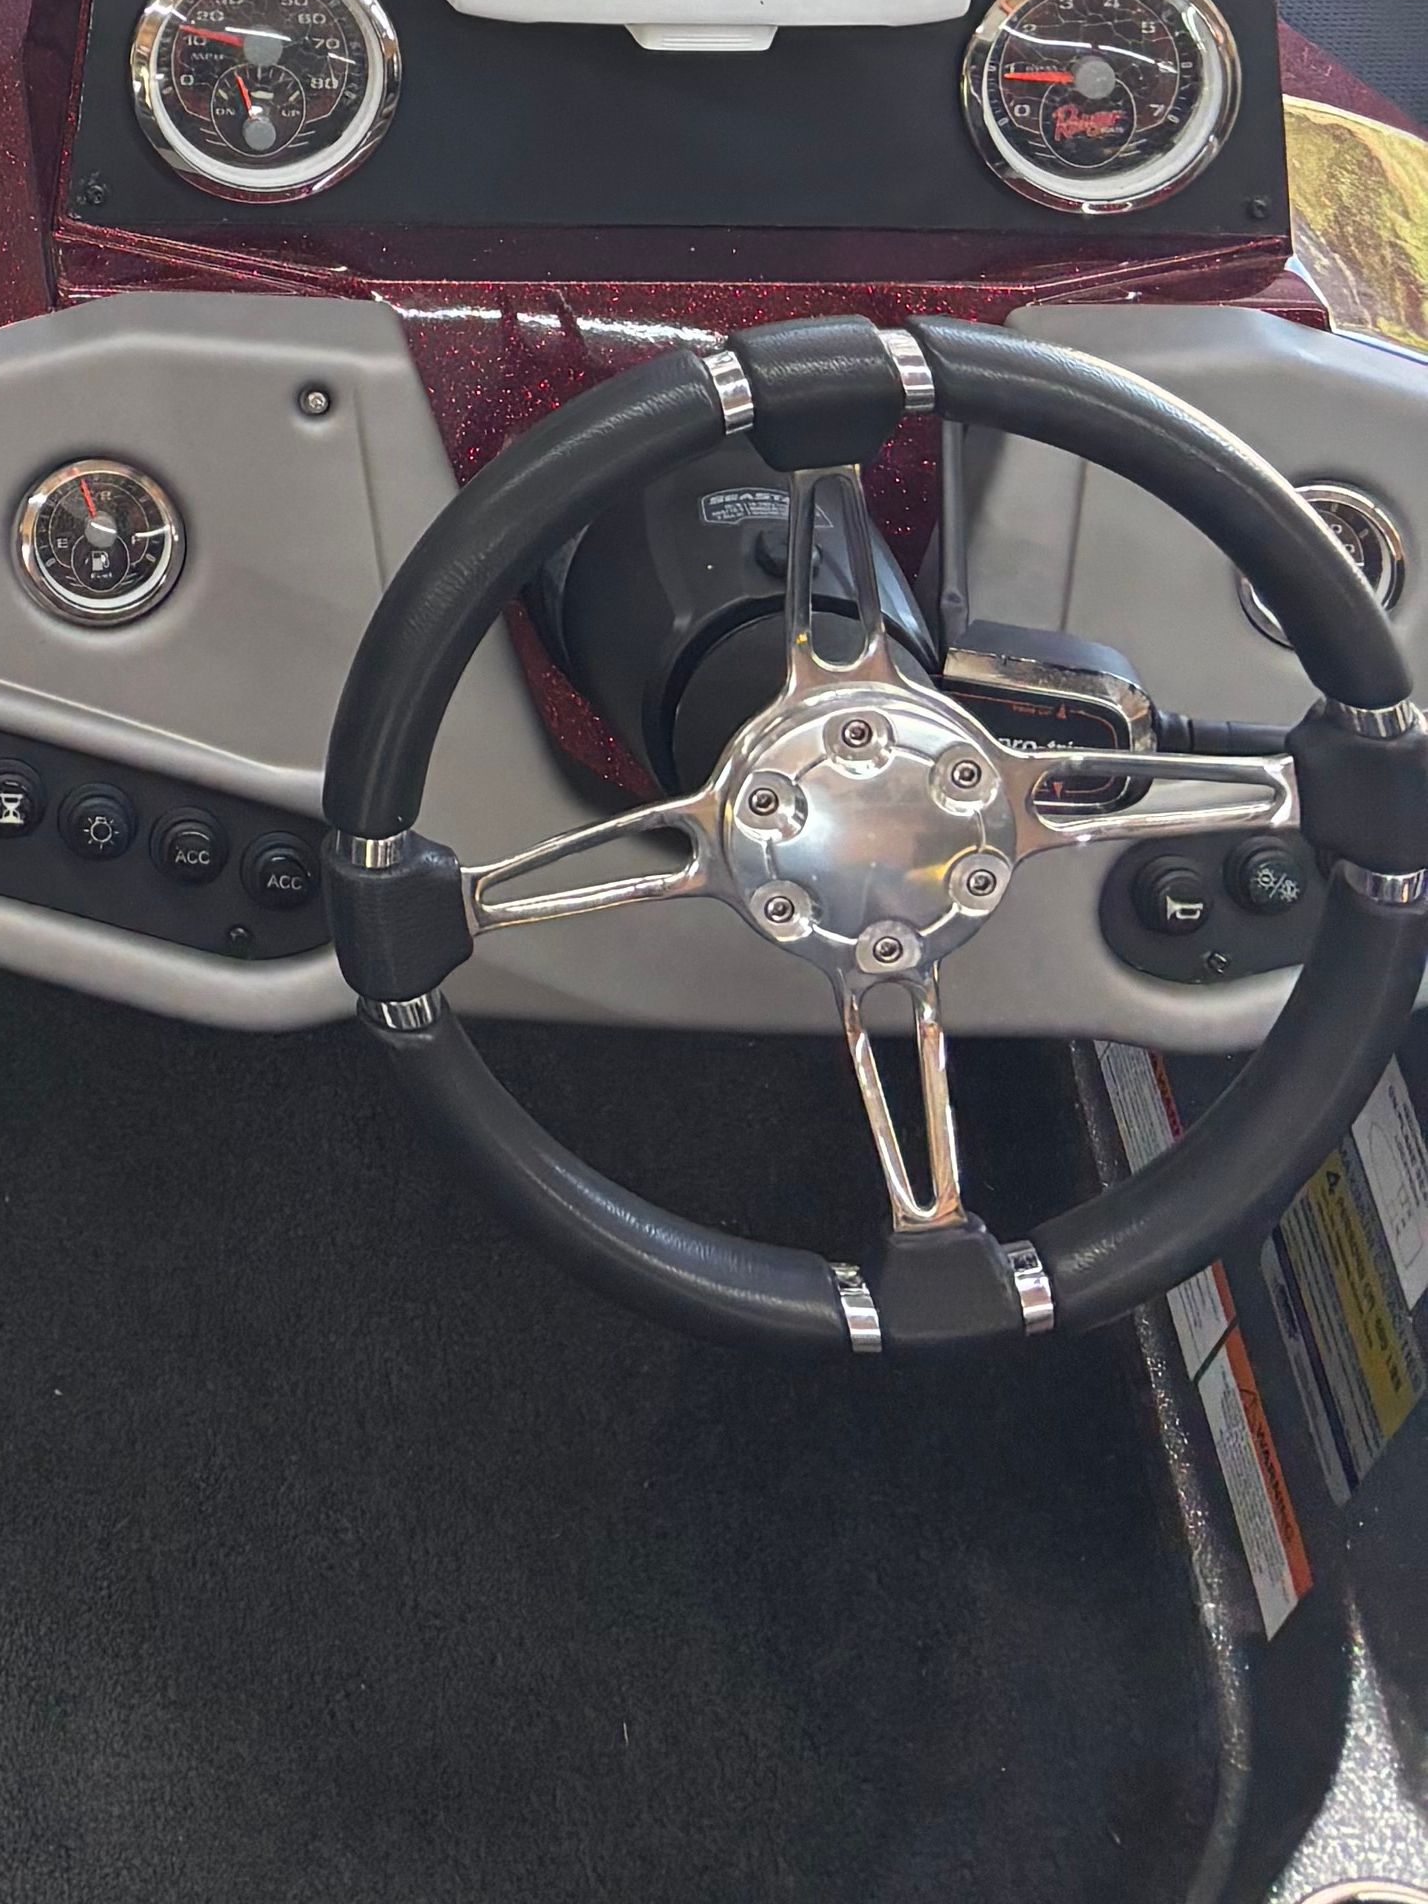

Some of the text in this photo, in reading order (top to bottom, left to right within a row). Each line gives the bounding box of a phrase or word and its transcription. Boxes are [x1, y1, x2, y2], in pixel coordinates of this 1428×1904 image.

[195, 10, 225, 22] 20
[297, 12, 326, 25] 60
[1141, 20, 1156, 34] 5
[185, 36, 208, 47] 10
[311, 37, 340, 50] 70
[179, 74, 195, 86] 0
[309, 76, 339, 91] 80
[1014, 104, 1030, 117] 0
[1148, 103, 1164, 117] 7
[174, 849, 211, 865] ACC
[266, 874, 303, 890] ACC
